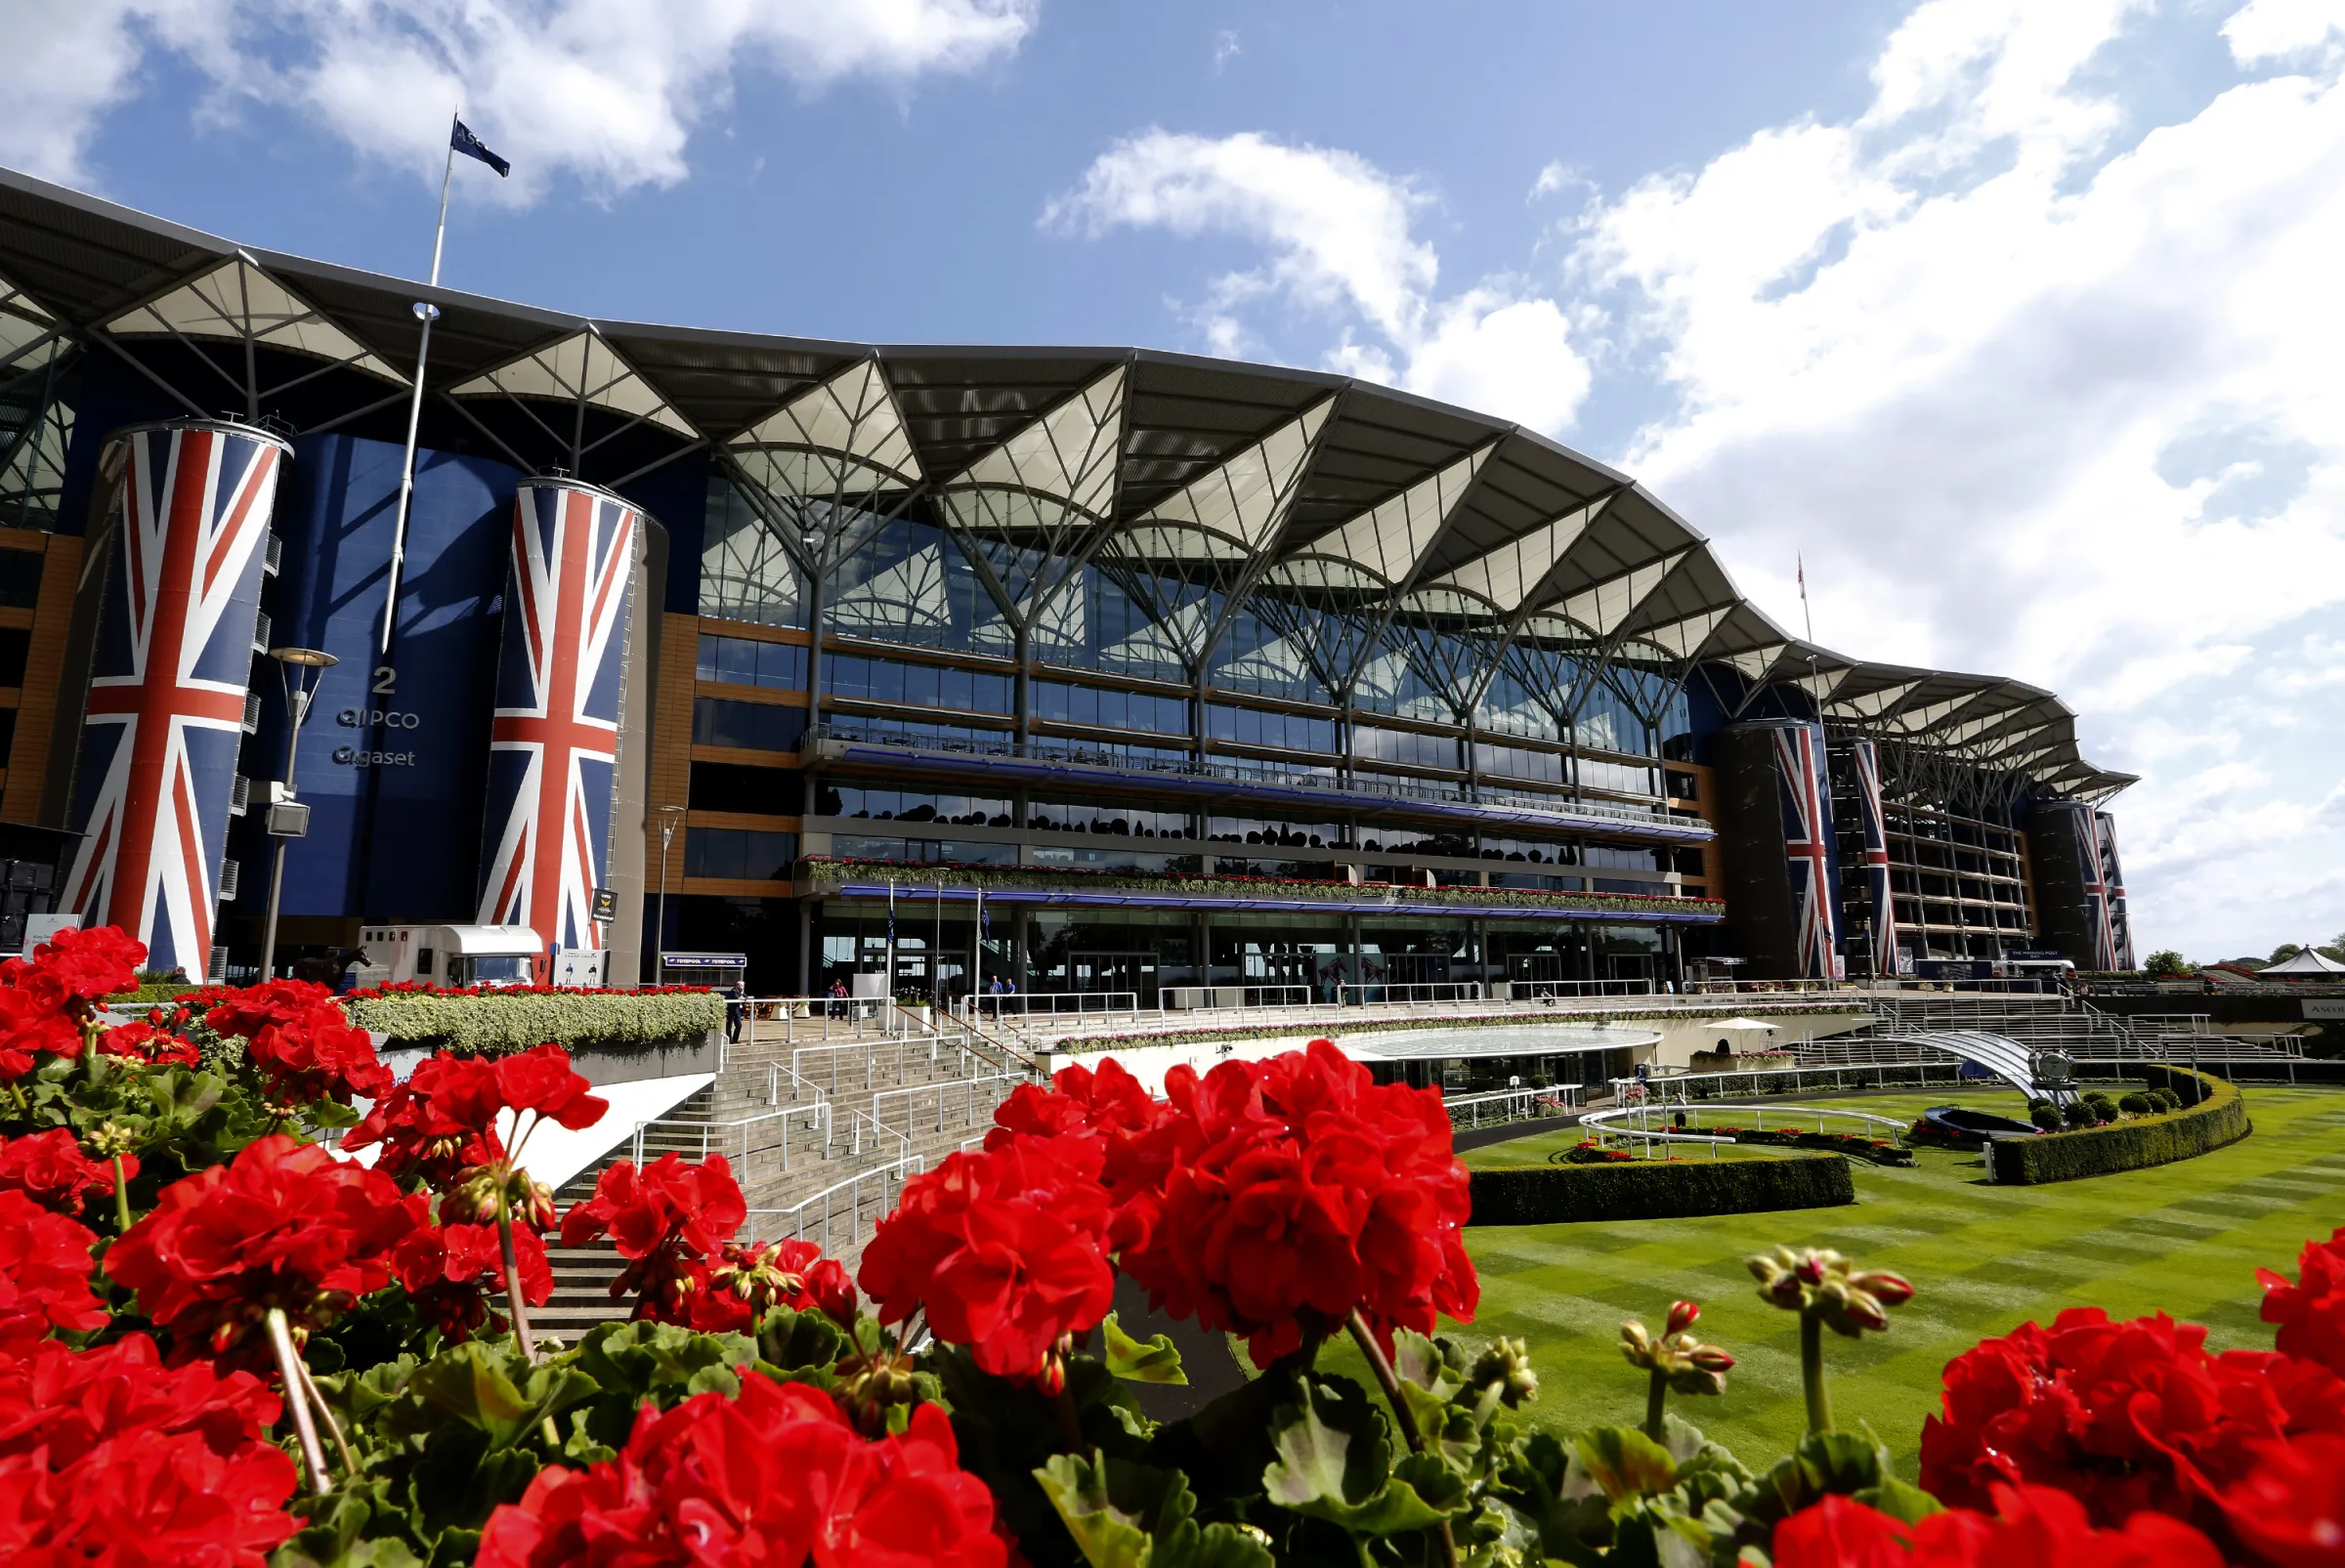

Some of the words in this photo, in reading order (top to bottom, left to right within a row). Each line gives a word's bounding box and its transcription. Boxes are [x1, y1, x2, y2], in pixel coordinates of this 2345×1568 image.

[372, 666, 397, 695] 2
[339, 708, 420, 730] QIPCO
[335, 745, 415, 768] Gigaset
